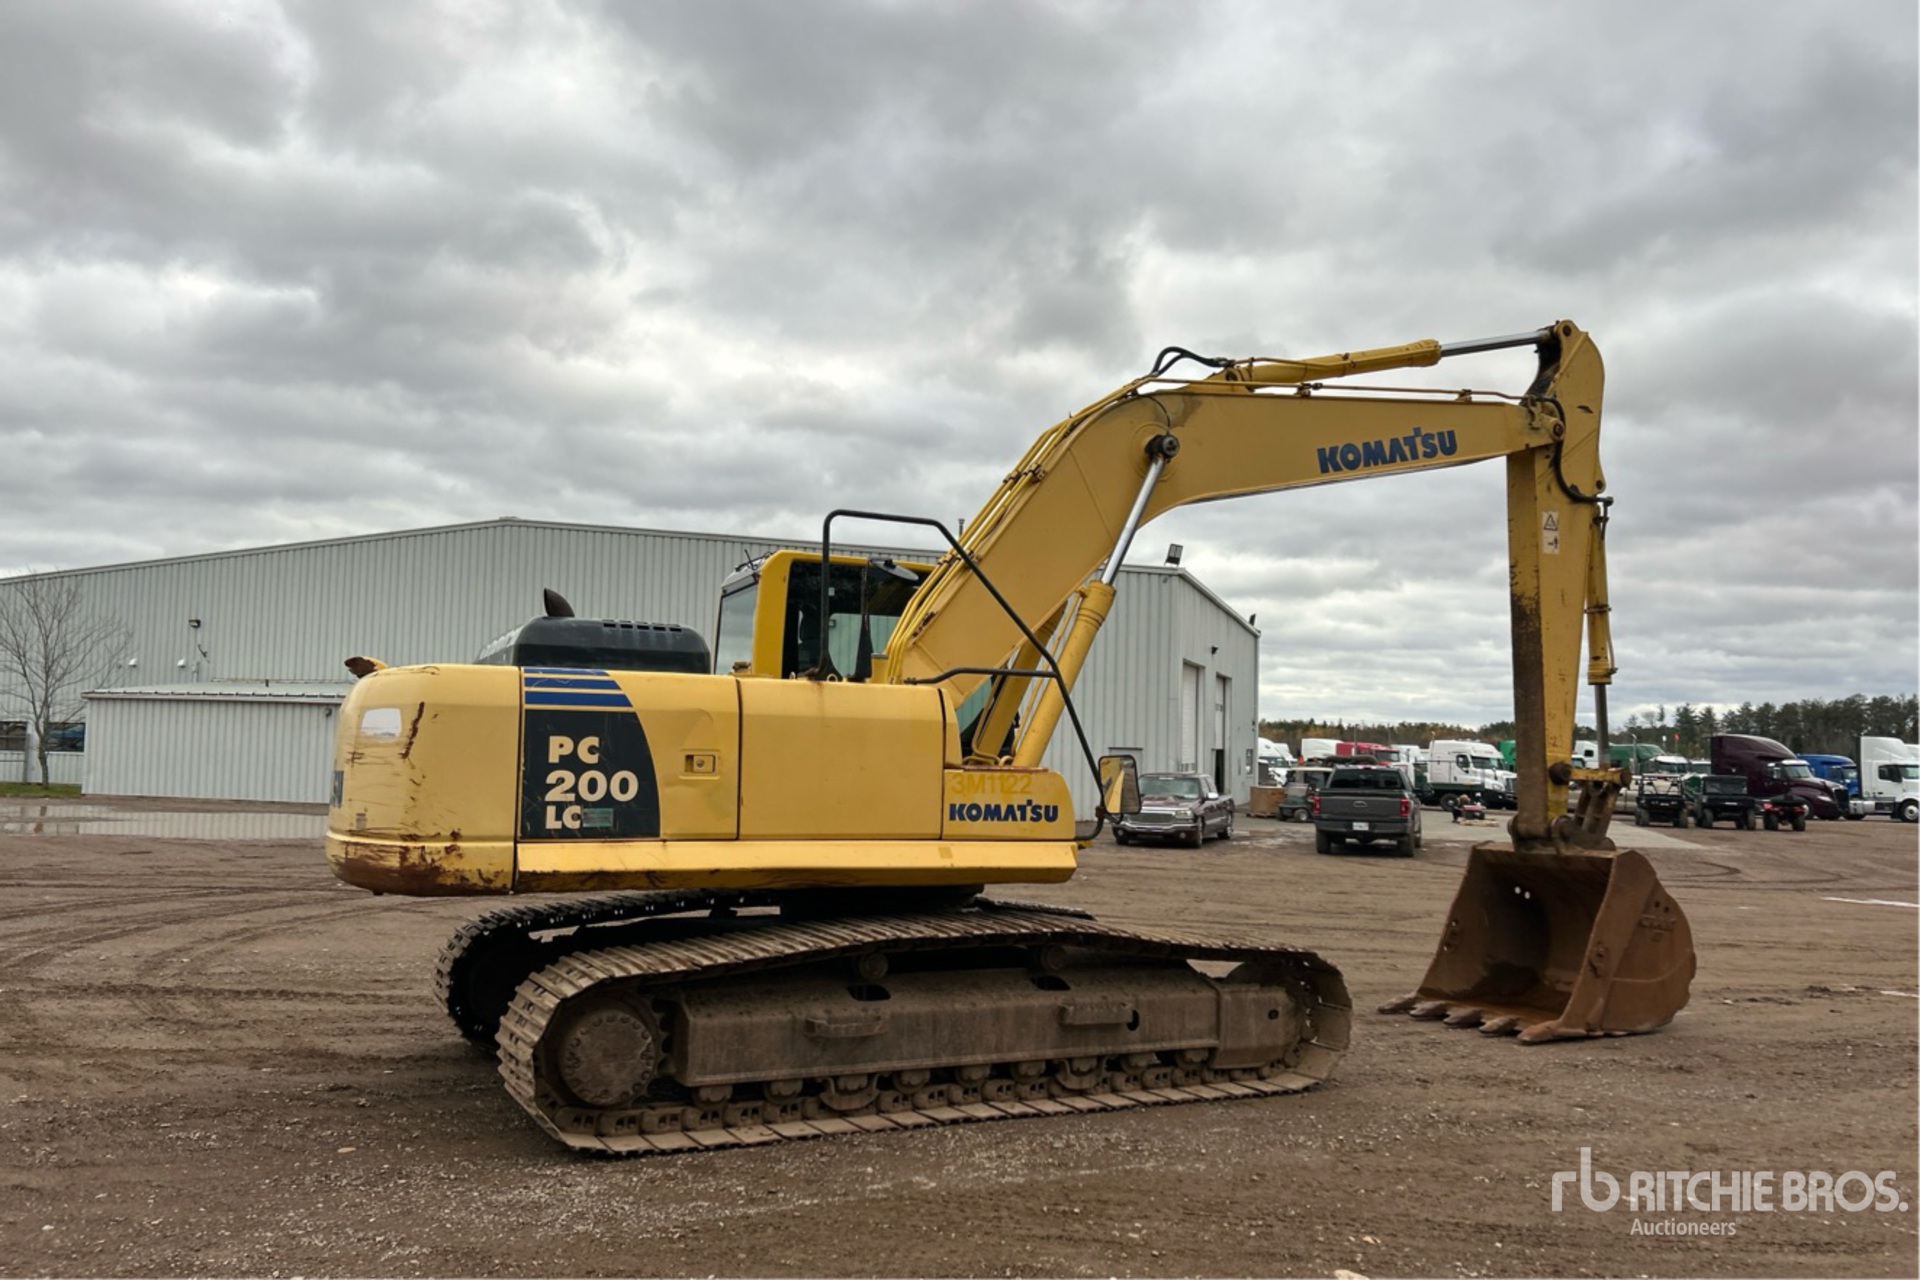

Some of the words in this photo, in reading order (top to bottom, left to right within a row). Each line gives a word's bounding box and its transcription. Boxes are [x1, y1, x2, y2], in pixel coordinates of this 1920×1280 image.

[1317, 427, 1457, 474] KOMATSU
[548, 735, 600, 764] PC
[545, 770, 639, 802] 200
[545, 805, 581, 829] LC
[949, 799, 1058, 822] KOMATSU
